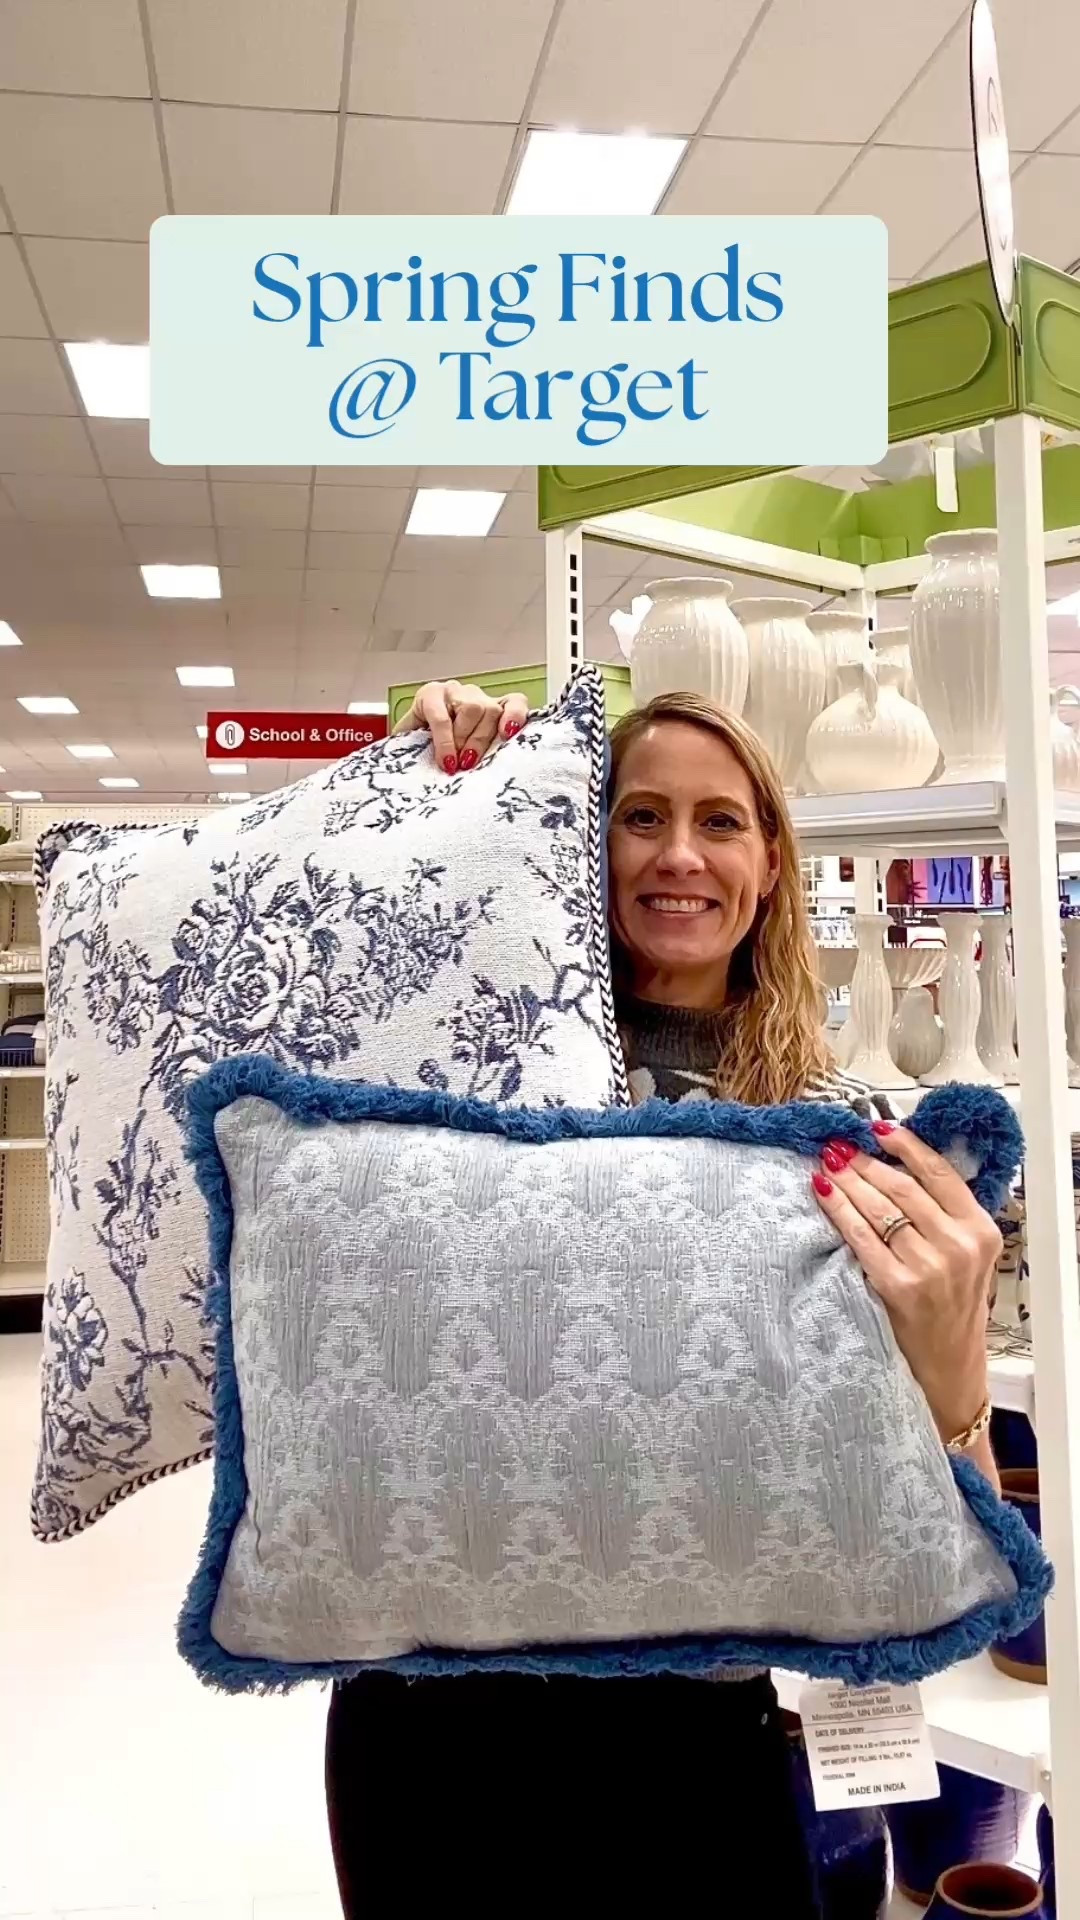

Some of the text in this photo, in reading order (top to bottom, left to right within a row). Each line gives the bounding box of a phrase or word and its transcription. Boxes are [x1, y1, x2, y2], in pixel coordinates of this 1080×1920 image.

[249, 728, 373, 742] School & Office
[895, 1704, 912, 1713] USA
[815, 1728, 829, 1737] DATE
[848, 1782, 906, 1796] MADE IN INDIA
